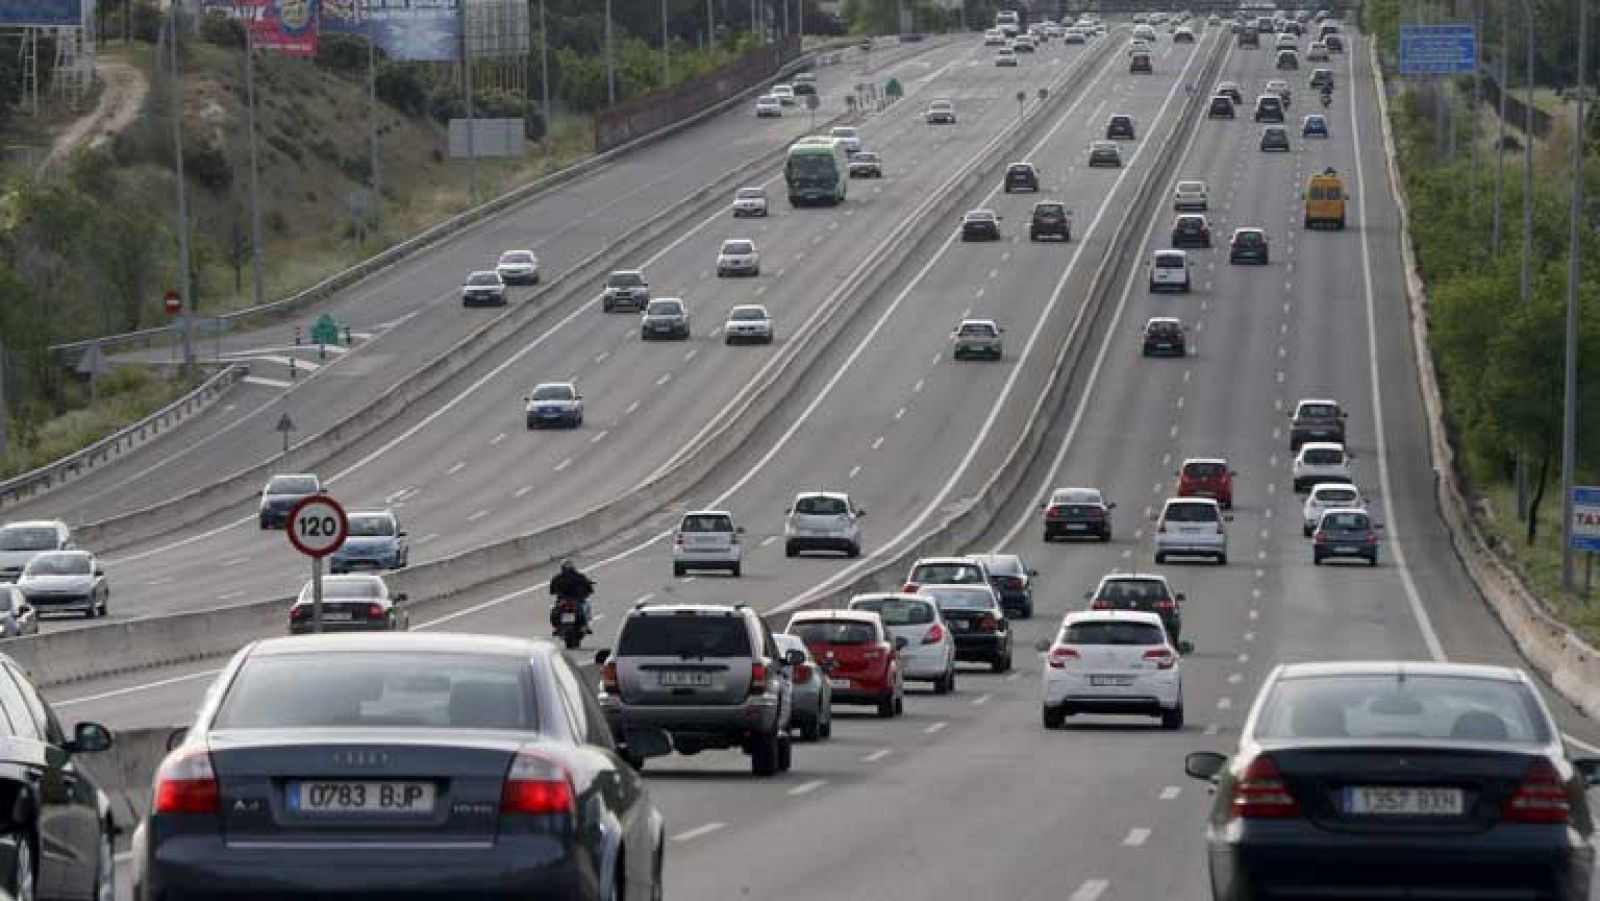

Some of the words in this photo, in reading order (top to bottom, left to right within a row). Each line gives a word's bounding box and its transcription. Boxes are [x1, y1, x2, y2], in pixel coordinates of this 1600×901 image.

[300, 517, 335, 536] 120
[310, 784, 366, 808] 0783
[380, 784, 423, 808] BJP
